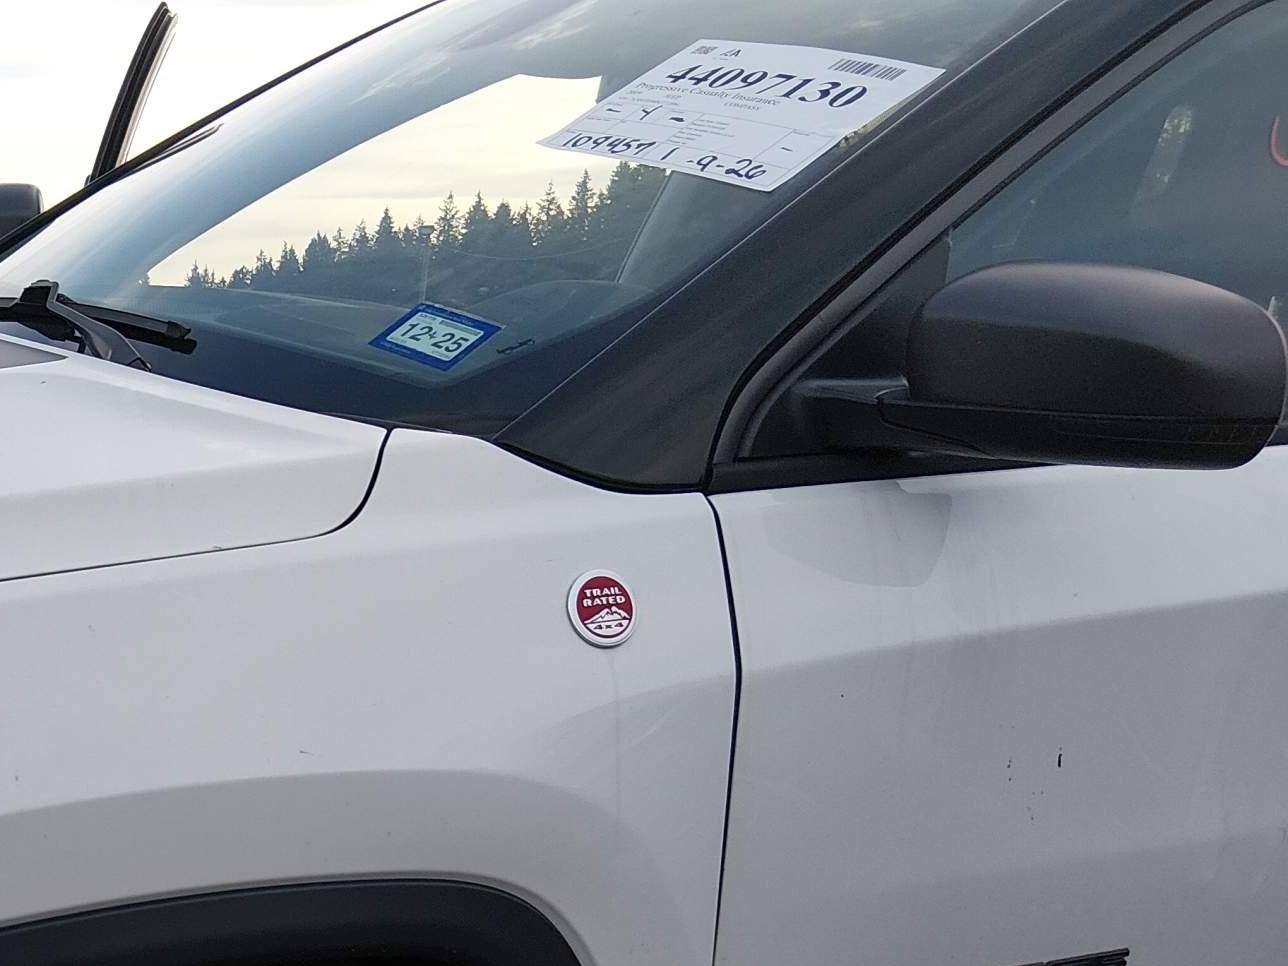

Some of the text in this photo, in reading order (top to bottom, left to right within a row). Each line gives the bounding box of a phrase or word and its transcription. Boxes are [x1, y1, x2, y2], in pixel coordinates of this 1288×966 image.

[665, 64, 868, 108] 44097130
[583, 586, 622, 597] TRAIL
[582, 595, 626, 607] RATED
